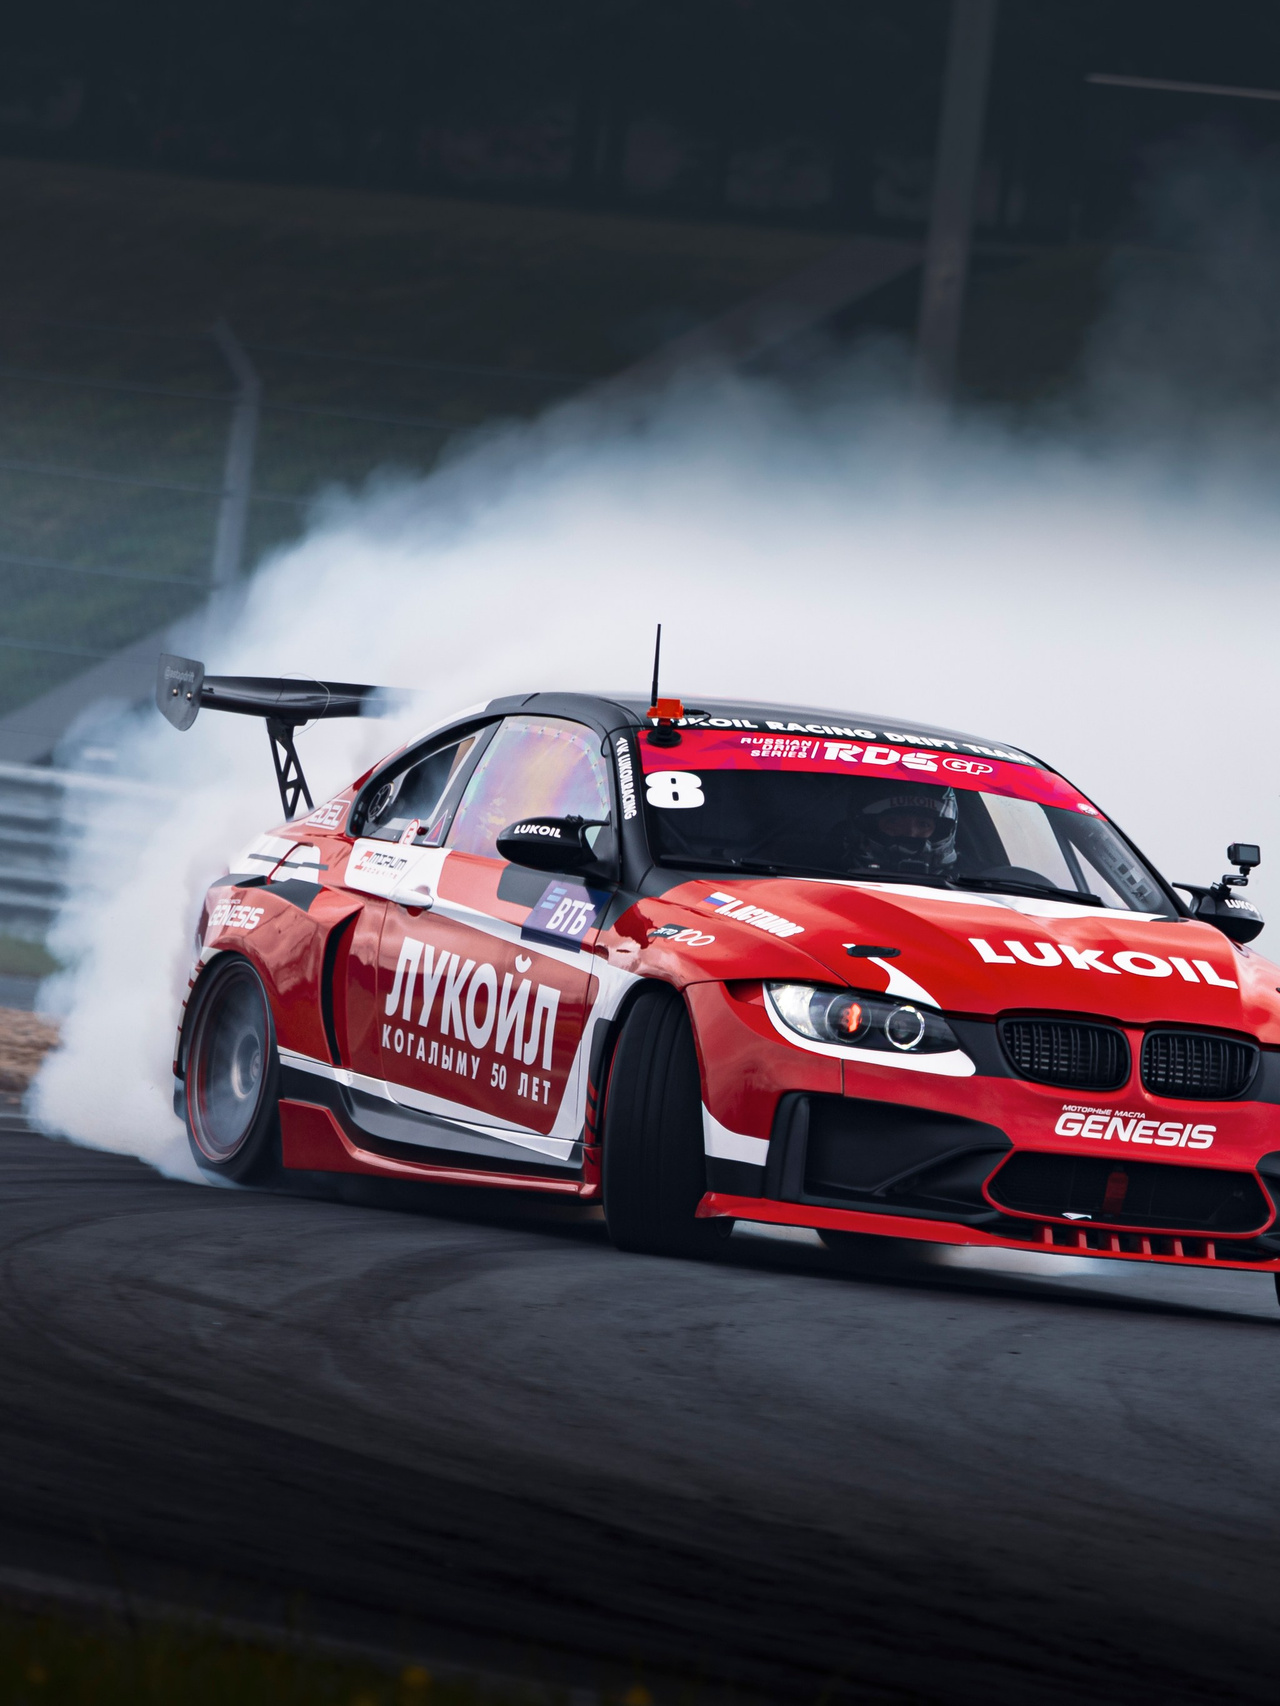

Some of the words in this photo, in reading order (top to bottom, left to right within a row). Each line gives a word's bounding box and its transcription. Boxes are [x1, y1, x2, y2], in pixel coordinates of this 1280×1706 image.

[740, 737, 812, 748] RUSSIAN
[750, 749, 807, 759] SERIES
[761, 743, 808, 753] DRIFT
[765, 721, 877, 740] RACING
[883, 732, 957, 750] DRIFT
[963, 743, 1037, 766] TEAM
[823, 741, 939, 773] RDS
[942, 757, 994, 776] GP
[645, 770, 705, 809] 8
[889, 795, 937, 809] LUKOIL
[514, 824, 562, 839] LUKOIL
[208, 904, 265, 930] GENESIS
[545, 897, 595, 936] ВТБ
[667, 928, 716, 947] 100
[968, 937, 1239, 990] LUKOIL
[384, 936, 561, 1072] ЛУКОЙЛ
[382, 1023, 480, 1080] КОГАЛЫМУ
[490, 1062, 507, 1090] 50
[517, 1072, 551, 1106] ЛЕТ
[1062, 1104, 1112, 1116] МОТОРНЫЕ
[1114, 1110, 1146, 1119] МАСЛА
[1054, 1112, 1217, 1149] GENESIS
